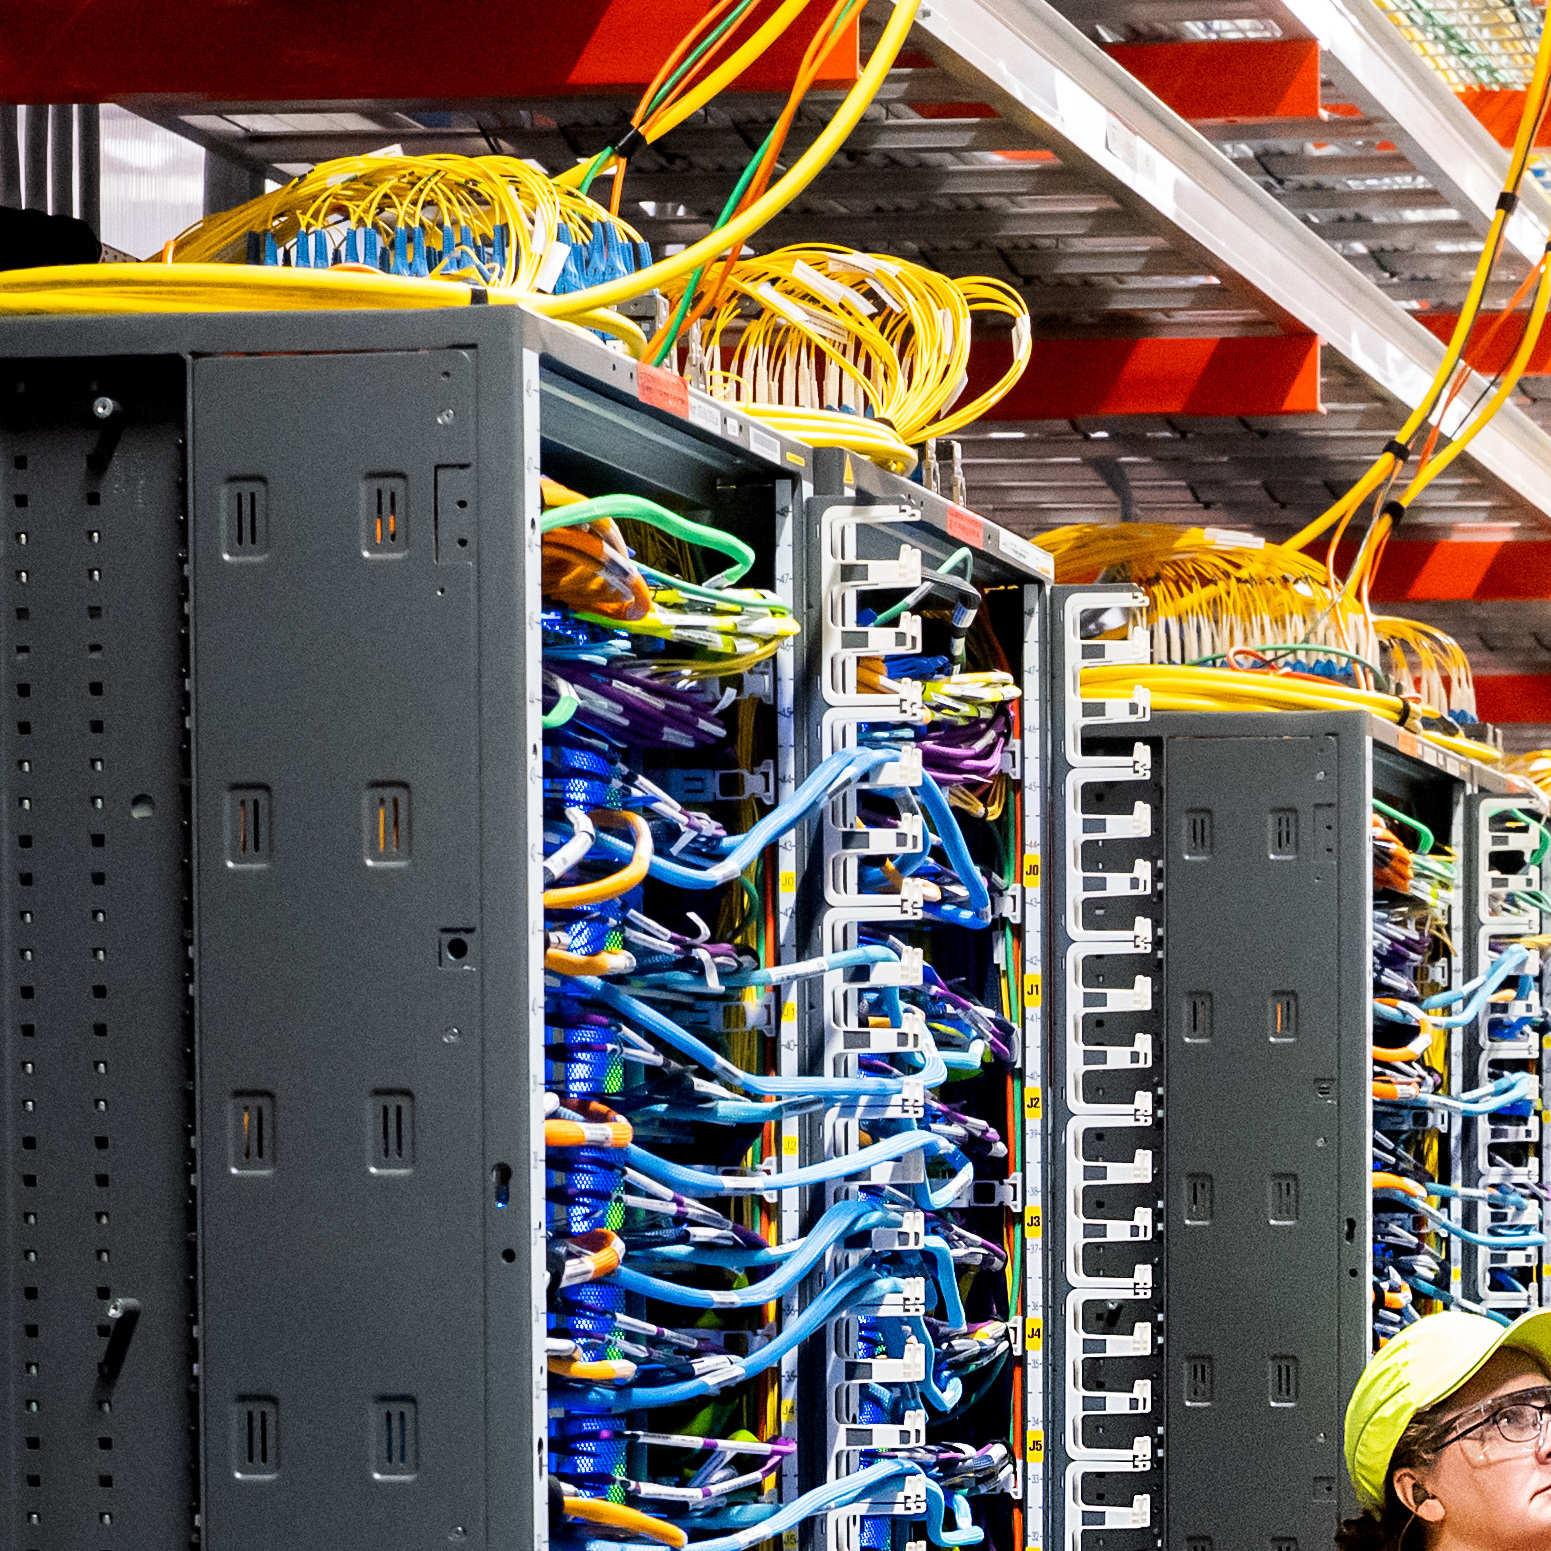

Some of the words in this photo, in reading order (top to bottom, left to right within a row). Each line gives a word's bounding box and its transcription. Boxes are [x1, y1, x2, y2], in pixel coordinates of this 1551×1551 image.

[780, 573, 789, 583] 47
[1028, 782, 1037, 791] 45
[1025, 864, 1039, 876] J0
[781, 877, 794, 886] J0
[1029, 897, 1038, 906] 43
[1027, 984, 1039, 996] J1
[784, 1007, 795, 1017] J1
[1029, 1013, 1038, 1022] 41
[785, 1039, 795, 1051] 40
[1030, 1071, 1039, 1080] 40
[1026, 1097, 1040, 1109] J2
[784, 1141, 796, 1150] J2
[1027, 1216, 1040, 1228] J3
[1030, 1245, 1039, 1254] 37
[1031, 1302, 1040, 1311] 36
[1027, 1327, 1041, 1339] J4
[1031, 1359, 1040, 1368] 35
[782, 1406, 794, 1416] J4
[1031, 1417, 1040, 1426] 34
[1029, 1440, 1042, 1451] J5
[1031, 1474, 1040, 1483] 33
[785, 1534, 796, 1544] J5
